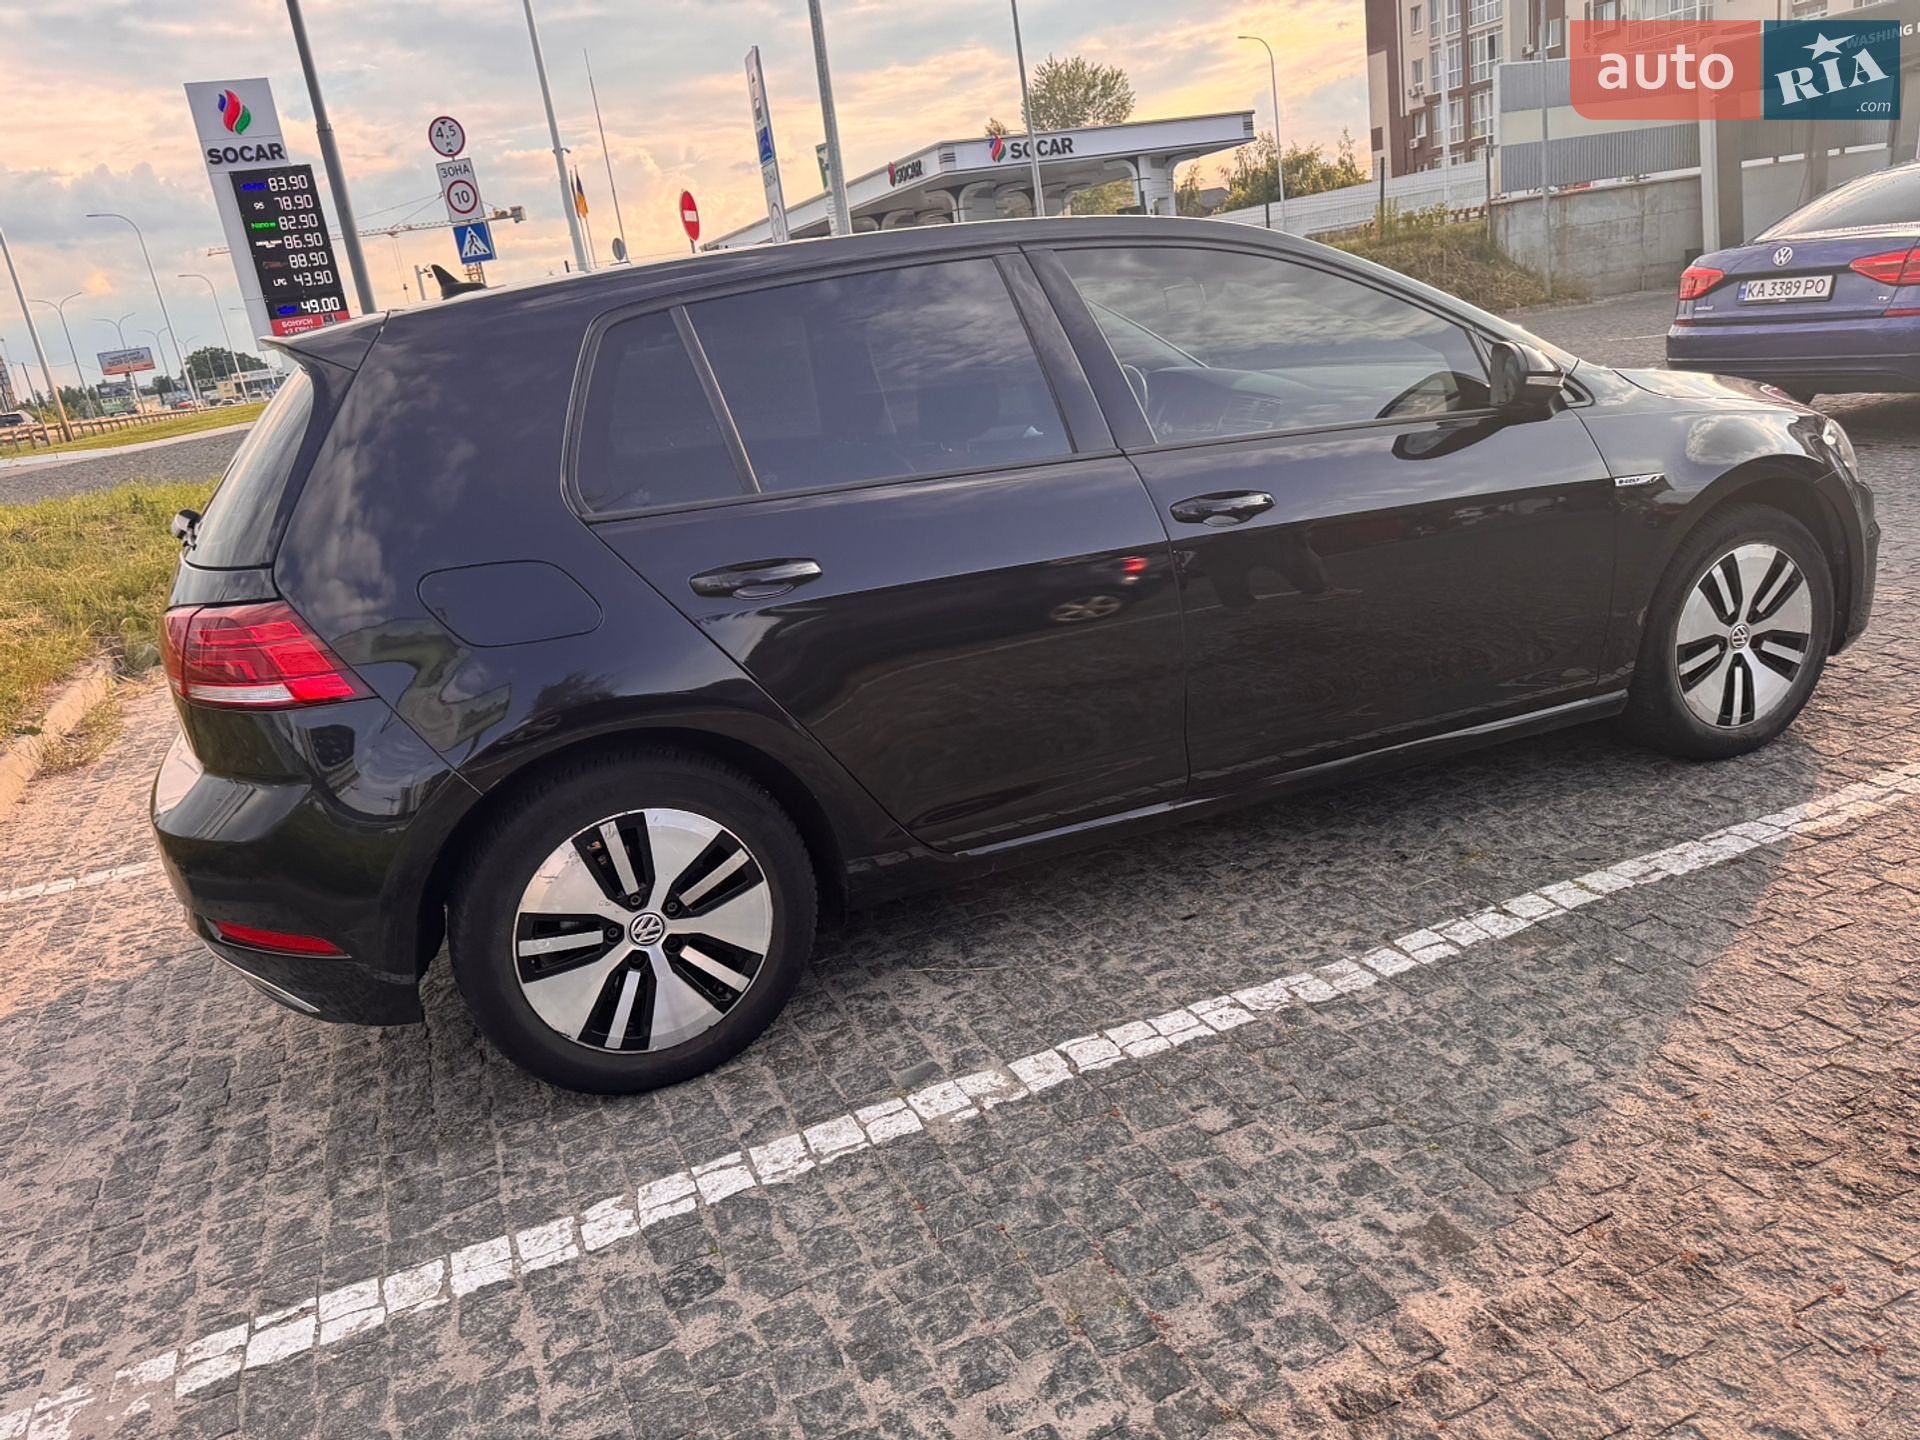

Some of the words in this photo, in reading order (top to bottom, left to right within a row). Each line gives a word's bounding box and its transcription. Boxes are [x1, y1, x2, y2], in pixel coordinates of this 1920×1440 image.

[435, 125, 457, 139] 4,5
[207, 143, 285, 165] SOCAR
[440, 164, 471, 178] ЗОНА
[267, 174, 308, 191] 83.90
[273, 194, 314, 210] 78.90
[455, 190, 471, 204] 10
[278, 213, 318, 230] 82.90
[283, 232, 323, 249] 86.90
[288, 251, 328, 268] 88.90
[293, 270, 333, 286] 43.90
[1747, 282, 1766, 298] KA
[1768, 280, 1801, 297] 3389
[1803, 279, 1826, 295] PO
[300, 297, 340, 313] 49.00
